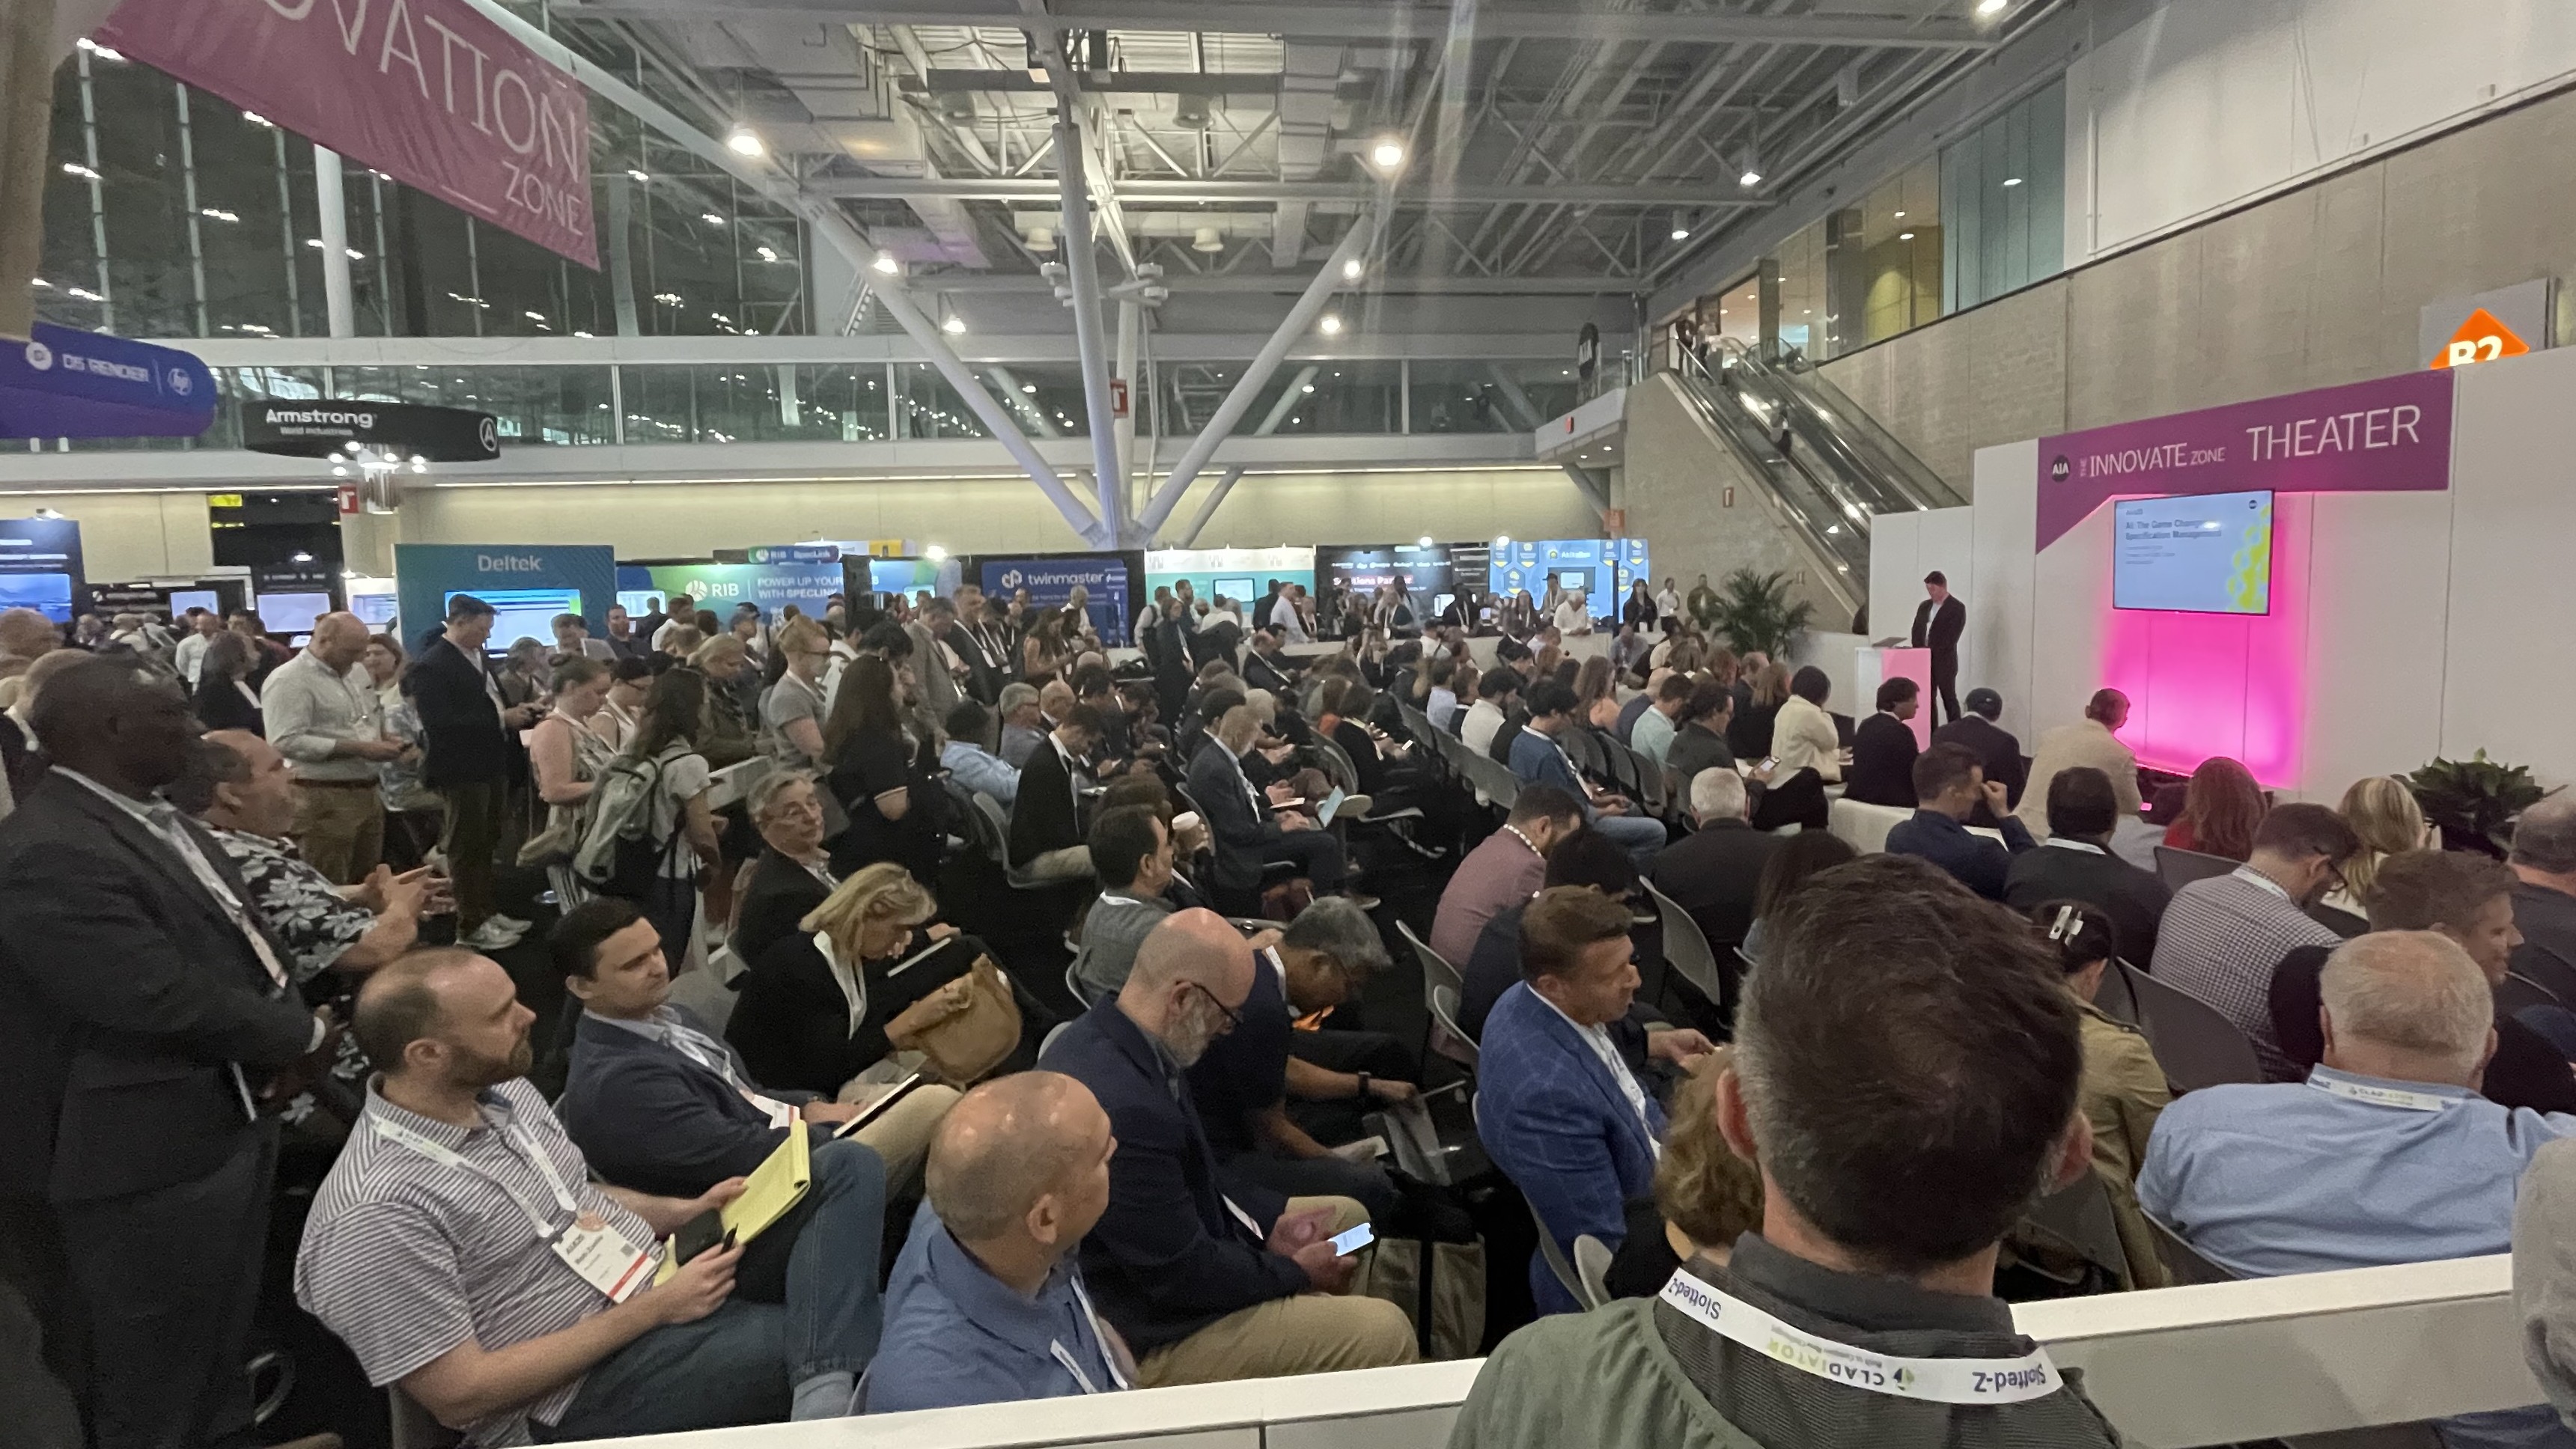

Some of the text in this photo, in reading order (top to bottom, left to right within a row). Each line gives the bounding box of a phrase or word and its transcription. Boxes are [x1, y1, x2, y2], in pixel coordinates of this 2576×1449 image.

[265, 0, 580, 183] VATION
[503, 160, 583, 236] ZONE
[266, 409, 374, 429] Armstrong
[2052, 462, 2069, 475] AIA
[2089, 442, 2187, 478] INNOVATE
[2189, 447, 2227, 466] ZONE
[2246, 404, 2422, 462] THEATER
[478, 554, 543, 572] Deltek
[757, 576, 795, 588] POWER
[797, 576, 812, 587] UP
[1027, 572, 1104, 586] twinmaster
[711, 583, 740, 598] RIB
[758, 588, 785, 600] WITH
[1971, 1362, 2047, 1393] Slotted-Z
